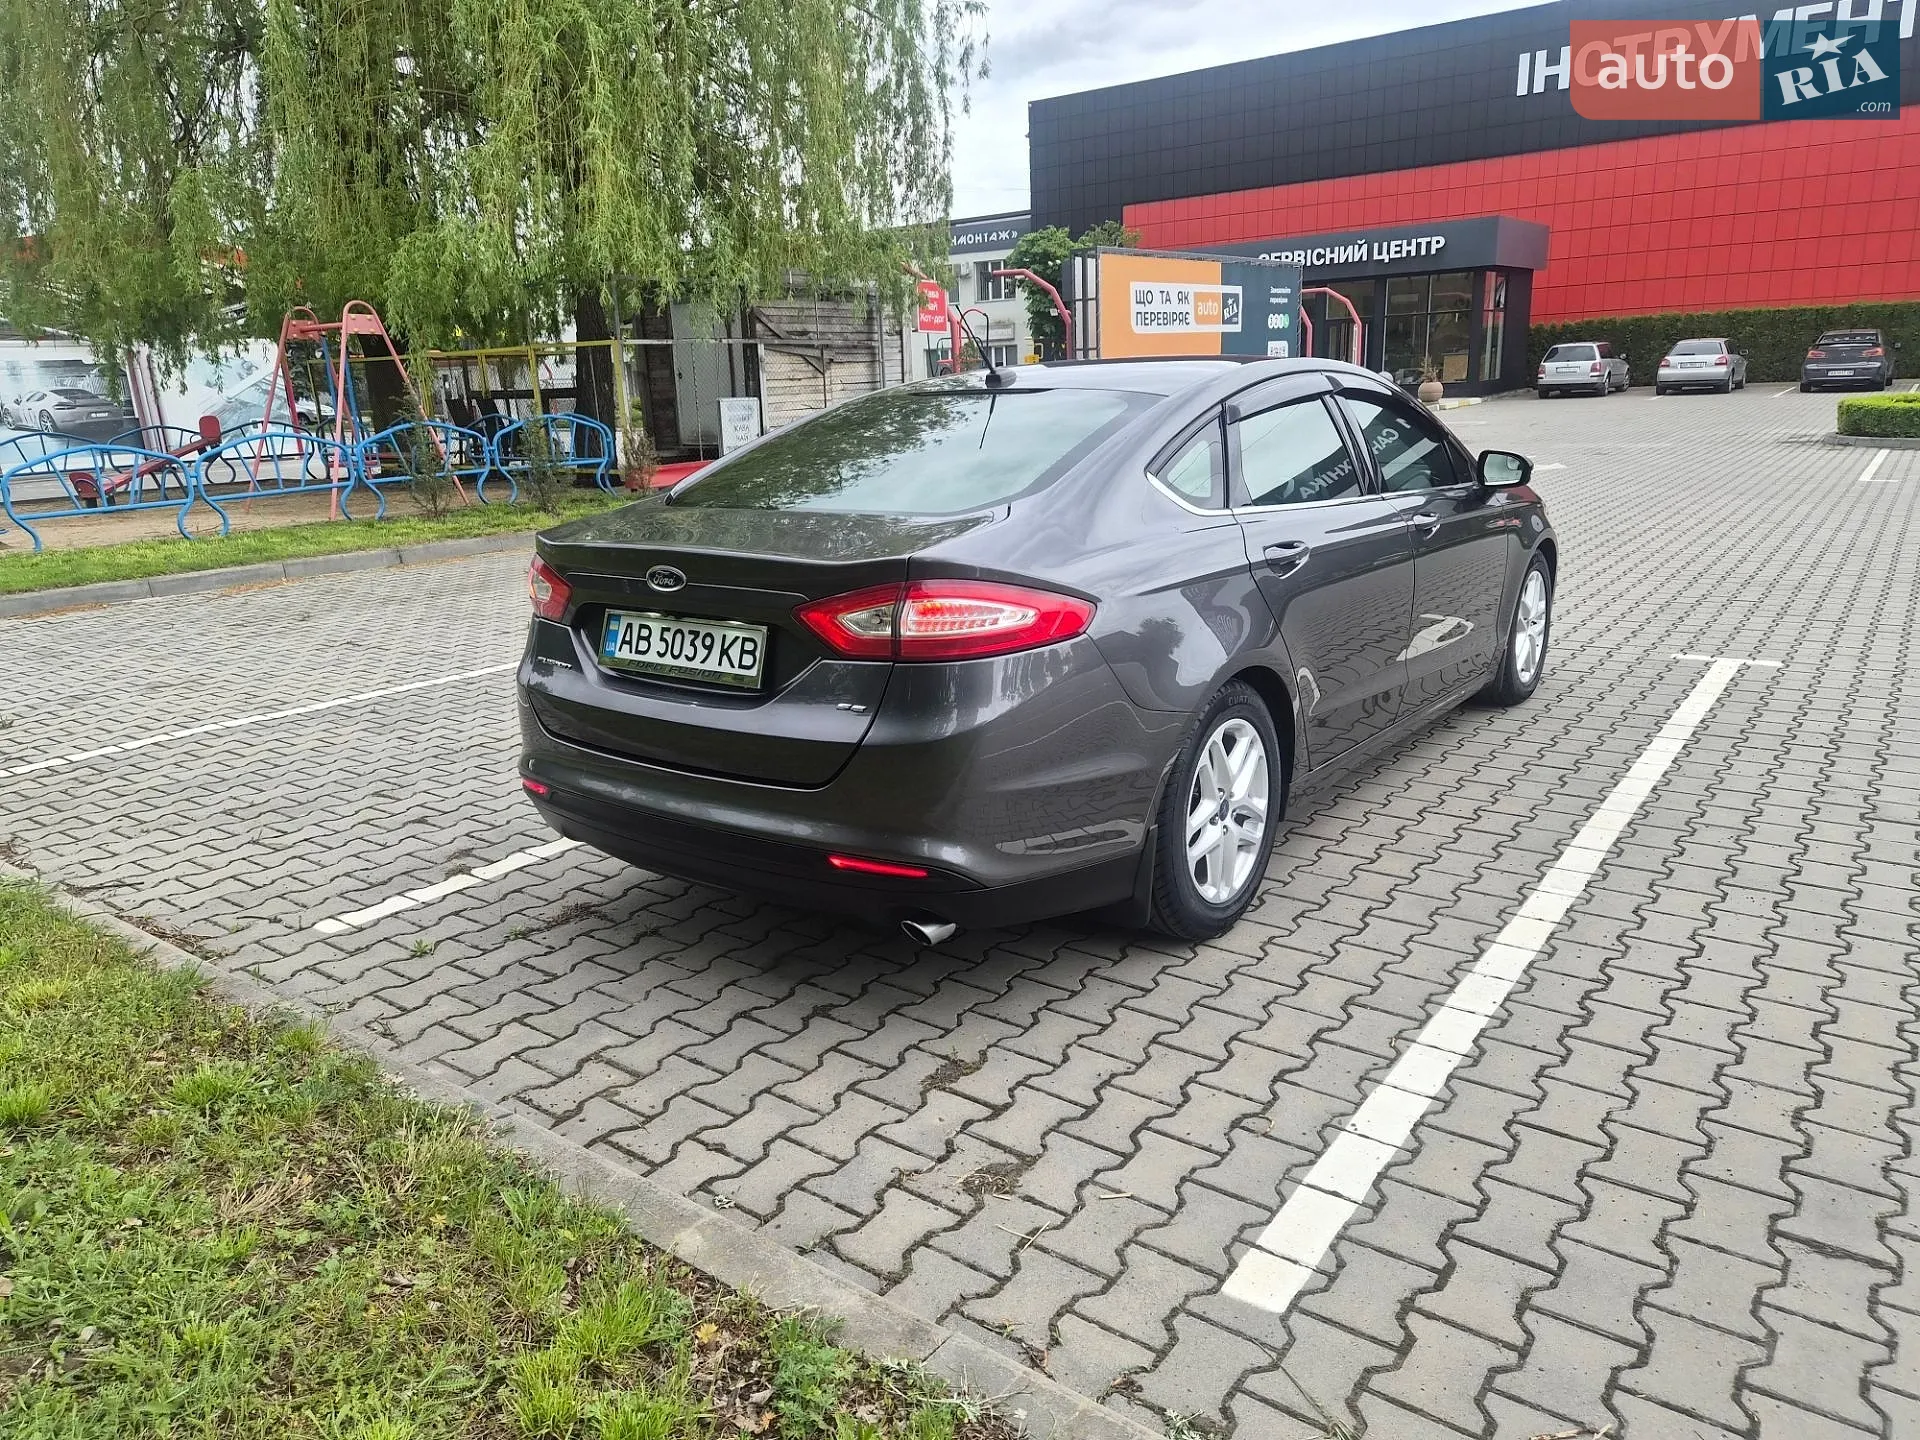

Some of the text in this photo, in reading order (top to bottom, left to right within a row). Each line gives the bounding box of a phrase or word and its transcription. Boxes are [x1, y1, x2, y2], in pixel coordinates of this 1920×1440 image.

[1373, 236, 1446, 264] ЦЕНТР
[1135, 289, 1190, 307] ЩО ТА ЯК
[1197, 300, 1218, 316] auto
[1135, 311, 1190, 326] ПЕРЕВІРЯЄ
[653, 574, 677, 586] Ford
[605, 622, 758, 670] UA AB 5039 KB
